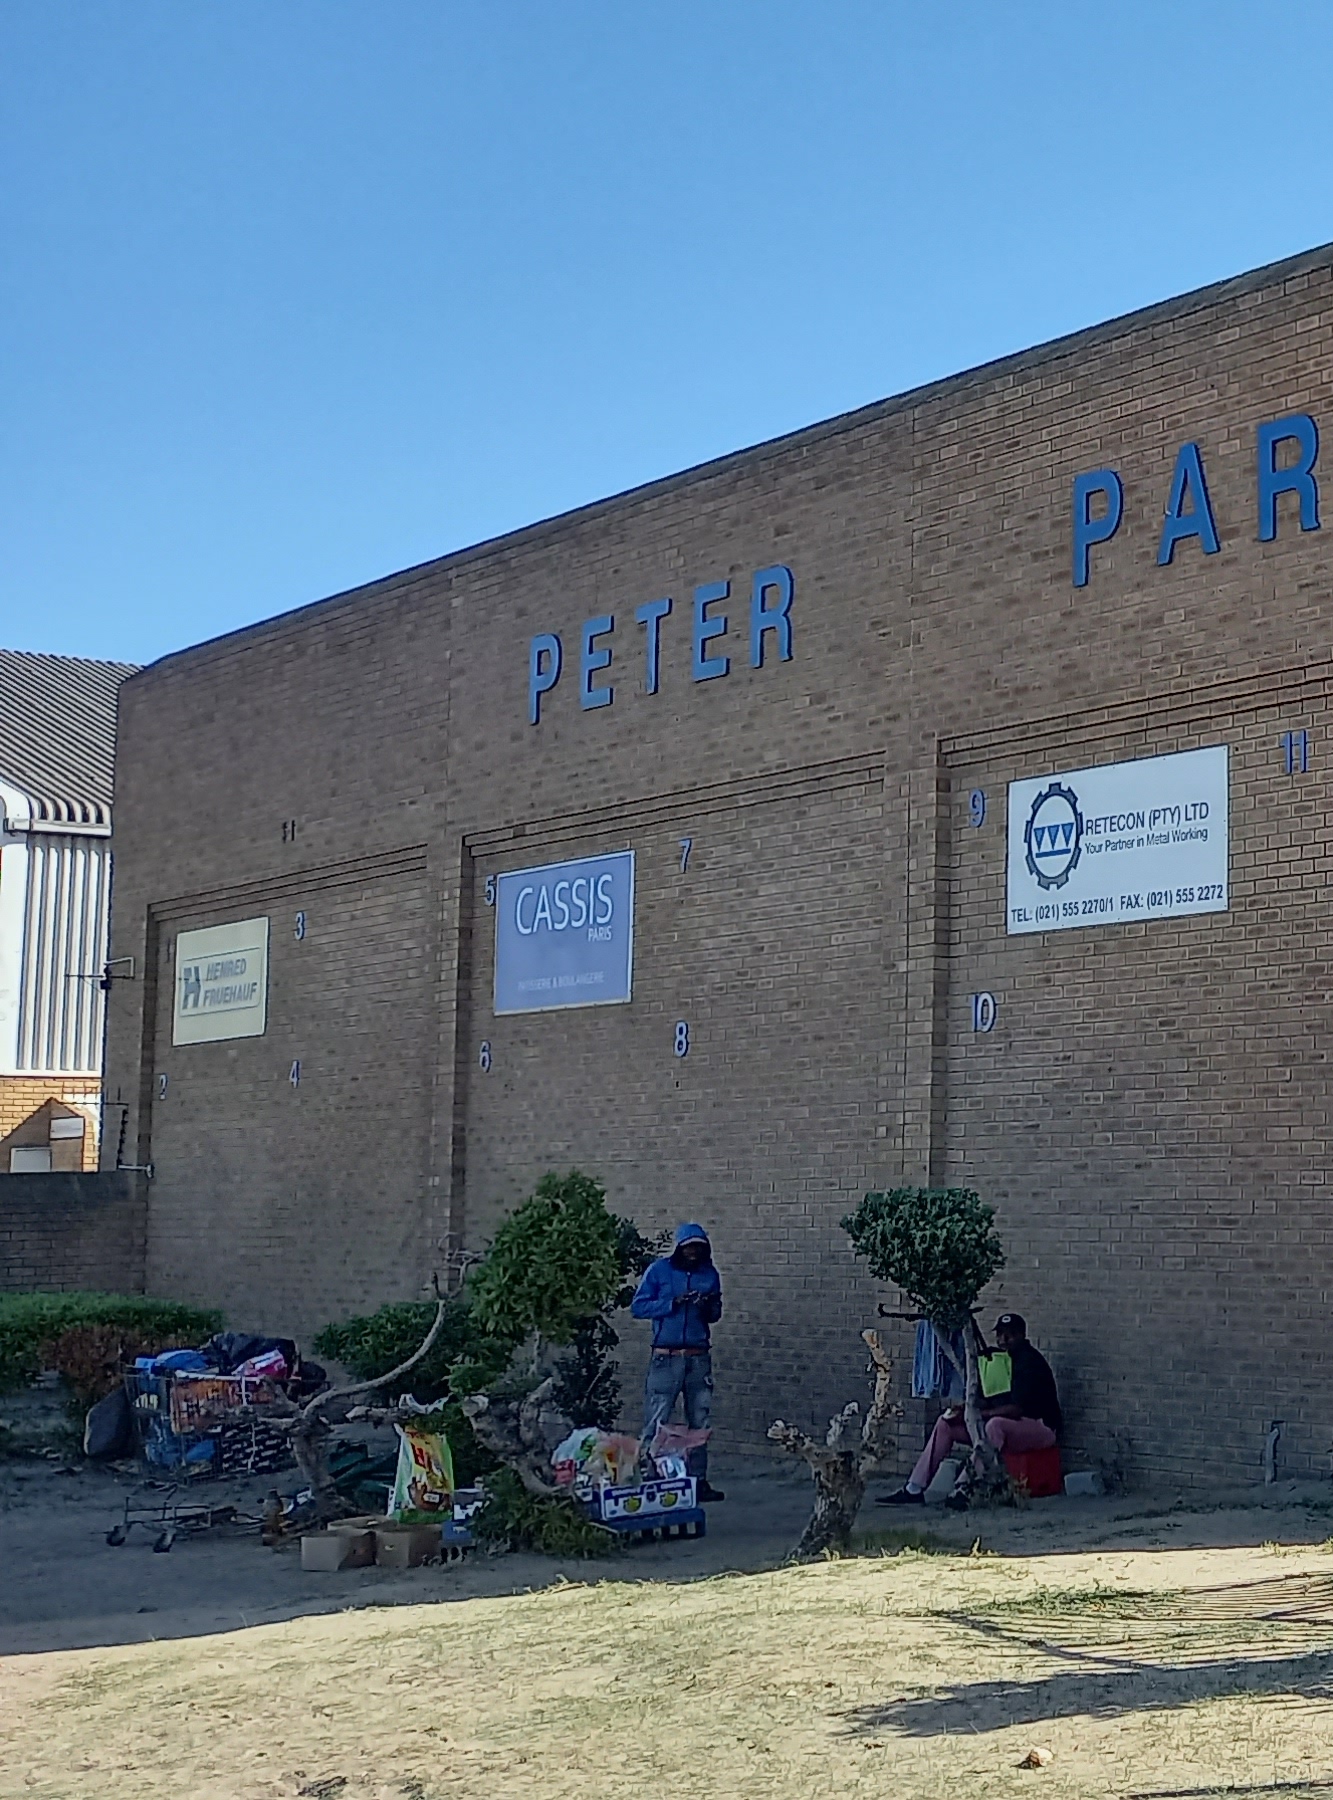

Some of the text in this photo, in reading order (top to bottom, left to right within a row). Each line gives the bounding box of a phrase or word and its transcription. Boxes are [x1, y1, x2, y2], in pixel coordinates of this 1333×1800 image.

[527, 563, 795, 726] PETER
[1281, 729, 1308, 774] 11
[969, 788, 986, 829] 9
[1085, 801, 1209, 836] RETECON (PTY) LTD
[678, 837, 693, 873] 7
[1084, 826, 1209, 855] Your Partner in Metal Working
[484, 874, 496, 907] 5
[515, 873, 614, 935] CASSIS
[1011, 883, 1224, 923] TEL: (021) 555 2270/1 FAX: (021) 555 2272
[294, 910, 305, 941] 3
[588, 925, 612, 942] PARIS
[206, 957, 247, 981] HENRED
[203, 981, 258, 1007] FRUEHAUF
[970, 990, 997, 1034] 10
[673, 1019, 690, 1058] 8
[289, 1059, 300, 1089] 4
[479, 1040, 492, 1075] 6
